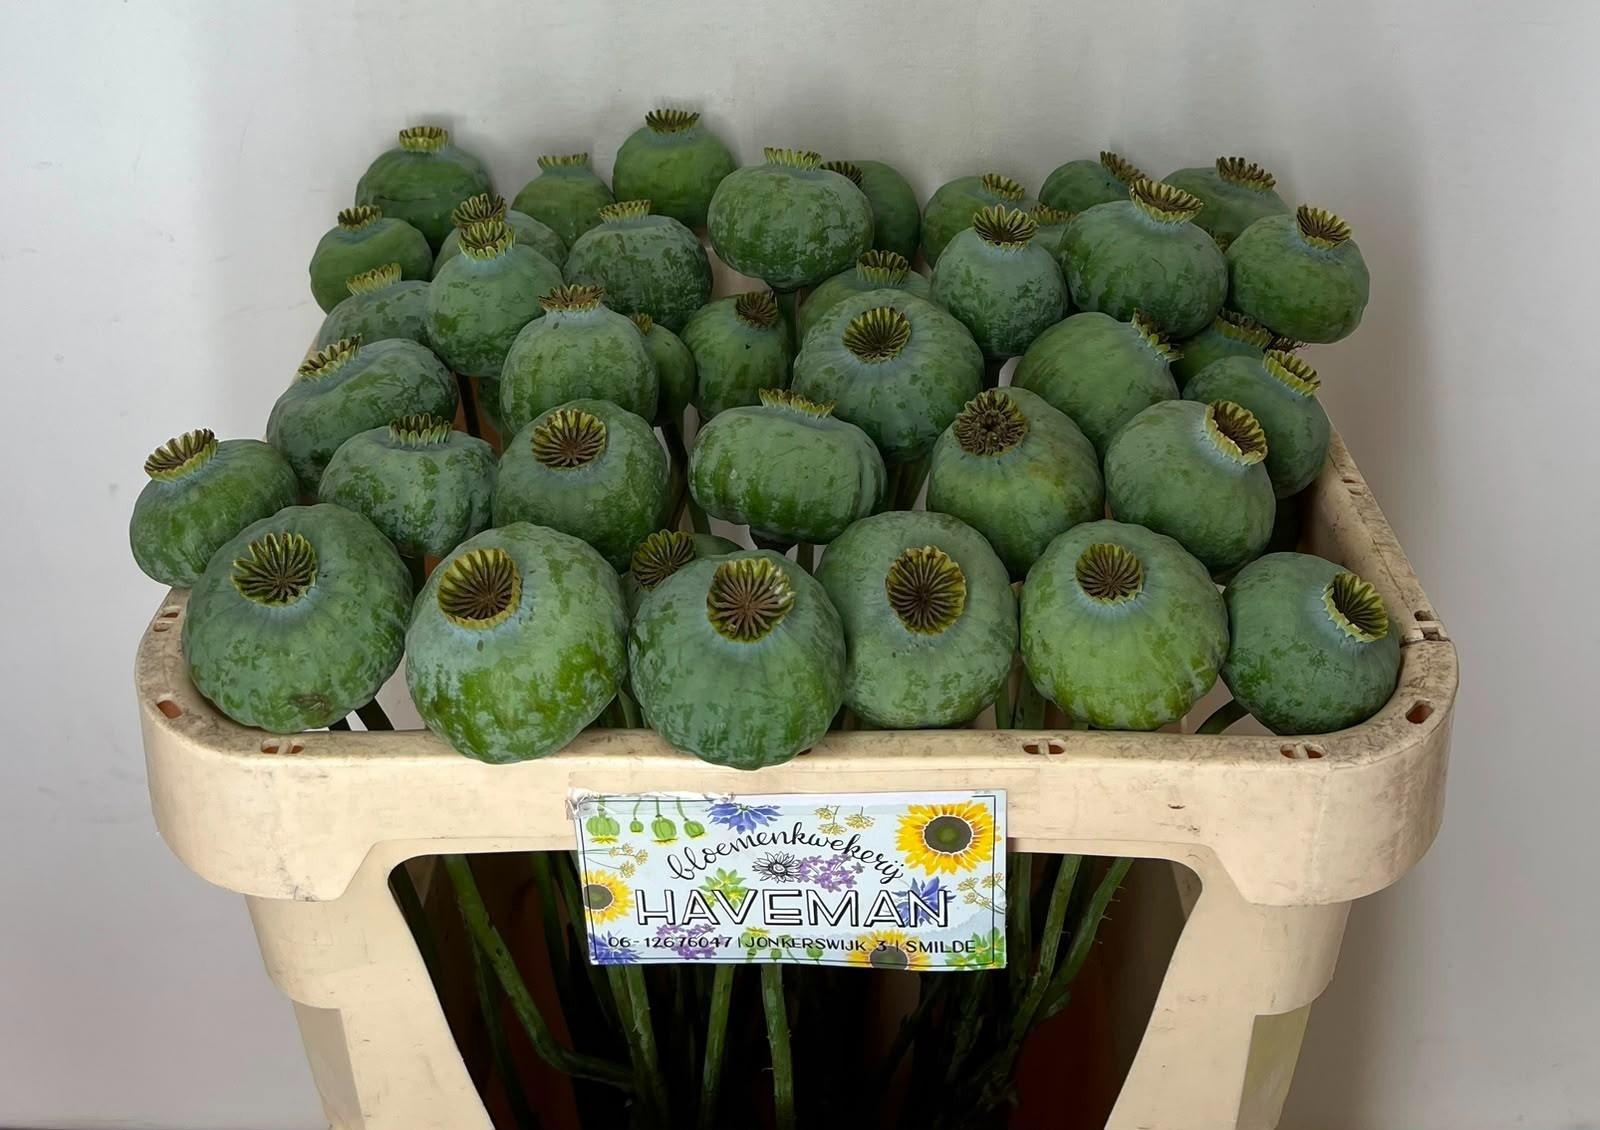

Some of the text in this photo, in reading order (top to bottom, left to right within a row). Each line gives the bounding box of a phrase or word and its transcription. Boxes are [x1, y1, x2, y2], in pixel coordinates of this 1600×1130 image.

[667, 821, 904, 885] bloemenkwekerij
[635, 889, 949, 927] HAVEMAN
[745, 936, 866, 952] JONKERSWIJK
[876, 940, 887, 952] 3
[905, 940, 976, 954] SMILDE
